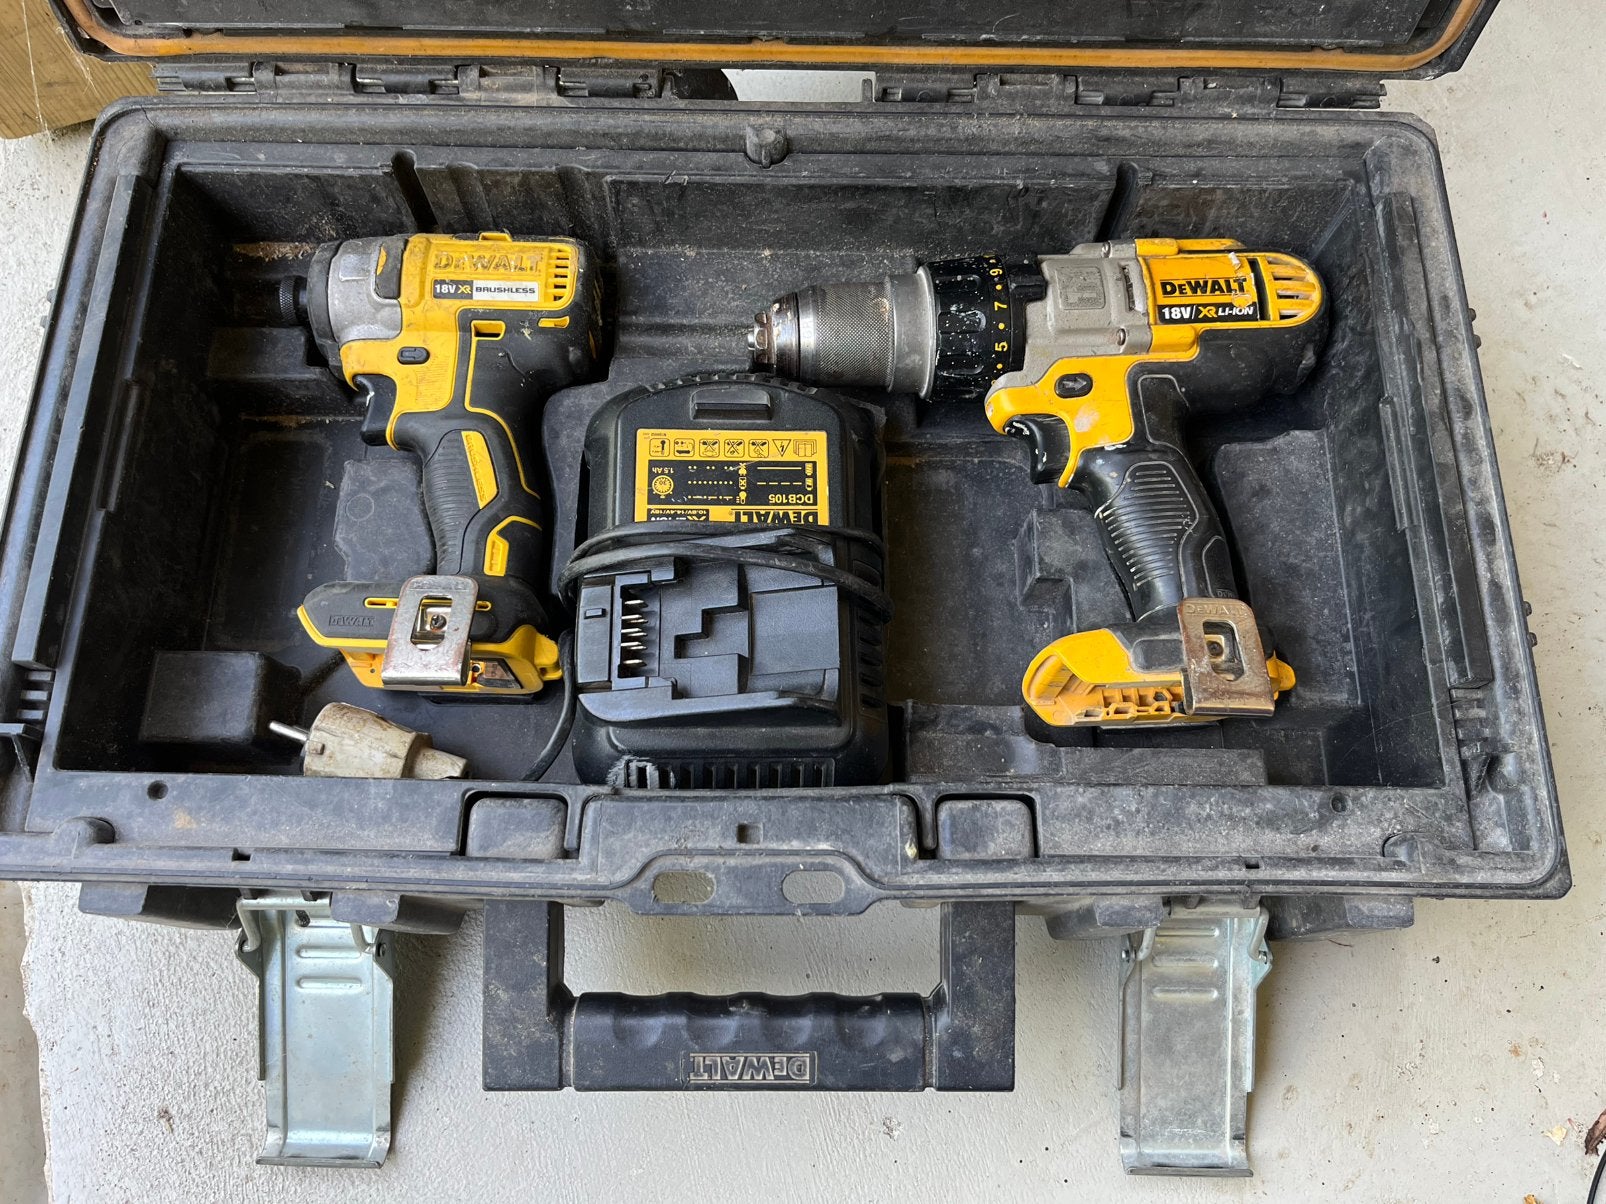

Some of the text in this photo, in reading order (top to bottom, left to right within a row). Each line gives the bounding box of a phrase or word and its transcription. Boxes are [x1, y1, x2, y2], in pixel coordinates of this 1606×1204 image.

[434, 252, 542, 272] DEWALT
[989, 268, 1003, 276] 9
[434, 285, 536, 294] 18V XR BRUSHLESS
[1160, 277, 1247, 296] DEWALT
[994, 301, 1008, 311] 7
[1218, 306, 1254, 316] LI-ION
[994, 341, 1008, 352] 5
[651, 466, 674, 474] 1.5 Ah
[768, 493, 814, 504] DCB105
[734, 510, 814, 524] DEWALT
[690, 1056, 810, 1080] DEWALT
